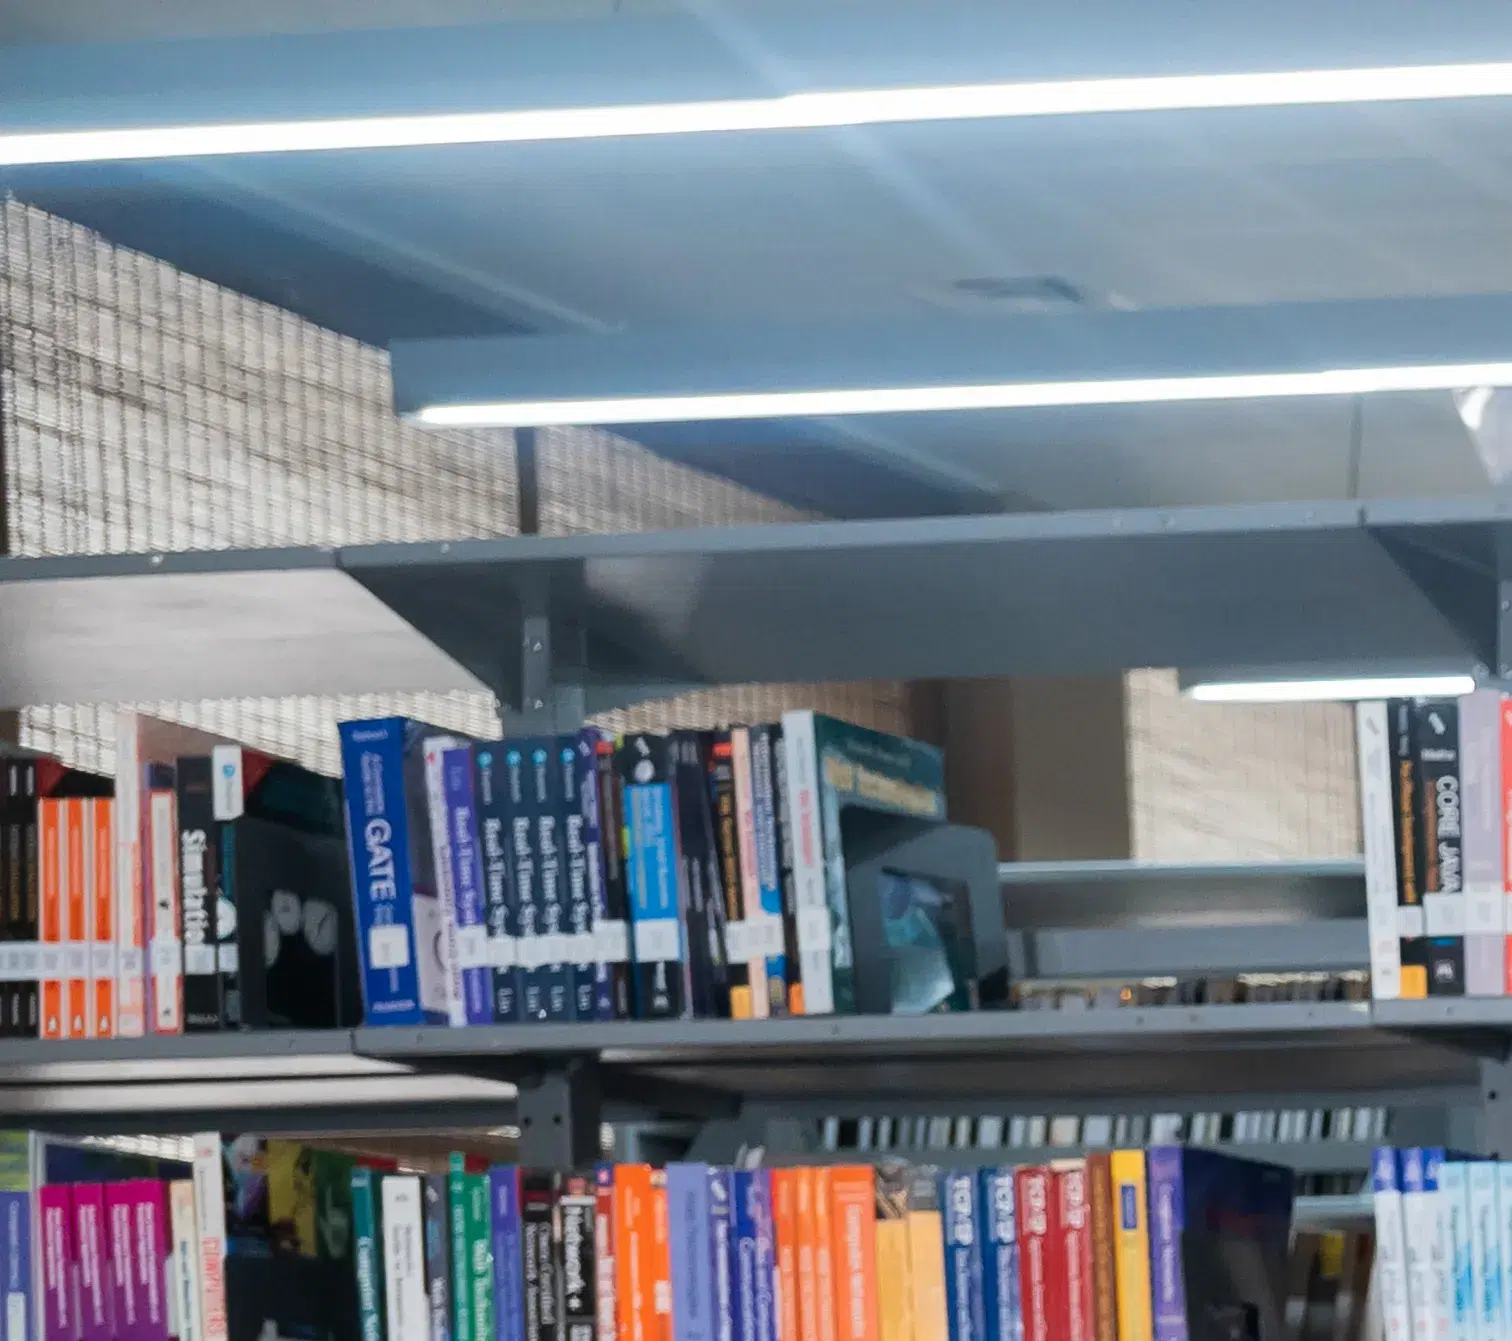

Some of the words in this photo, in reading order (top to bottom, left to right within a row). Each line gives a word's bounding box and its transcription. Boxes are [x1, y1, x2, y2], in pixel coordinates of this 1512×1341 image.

[1435, 776, 1458, 837] CORE
[364, 819, 396, 898] GATE
[1438, 841, 1460, 891] JAVA
